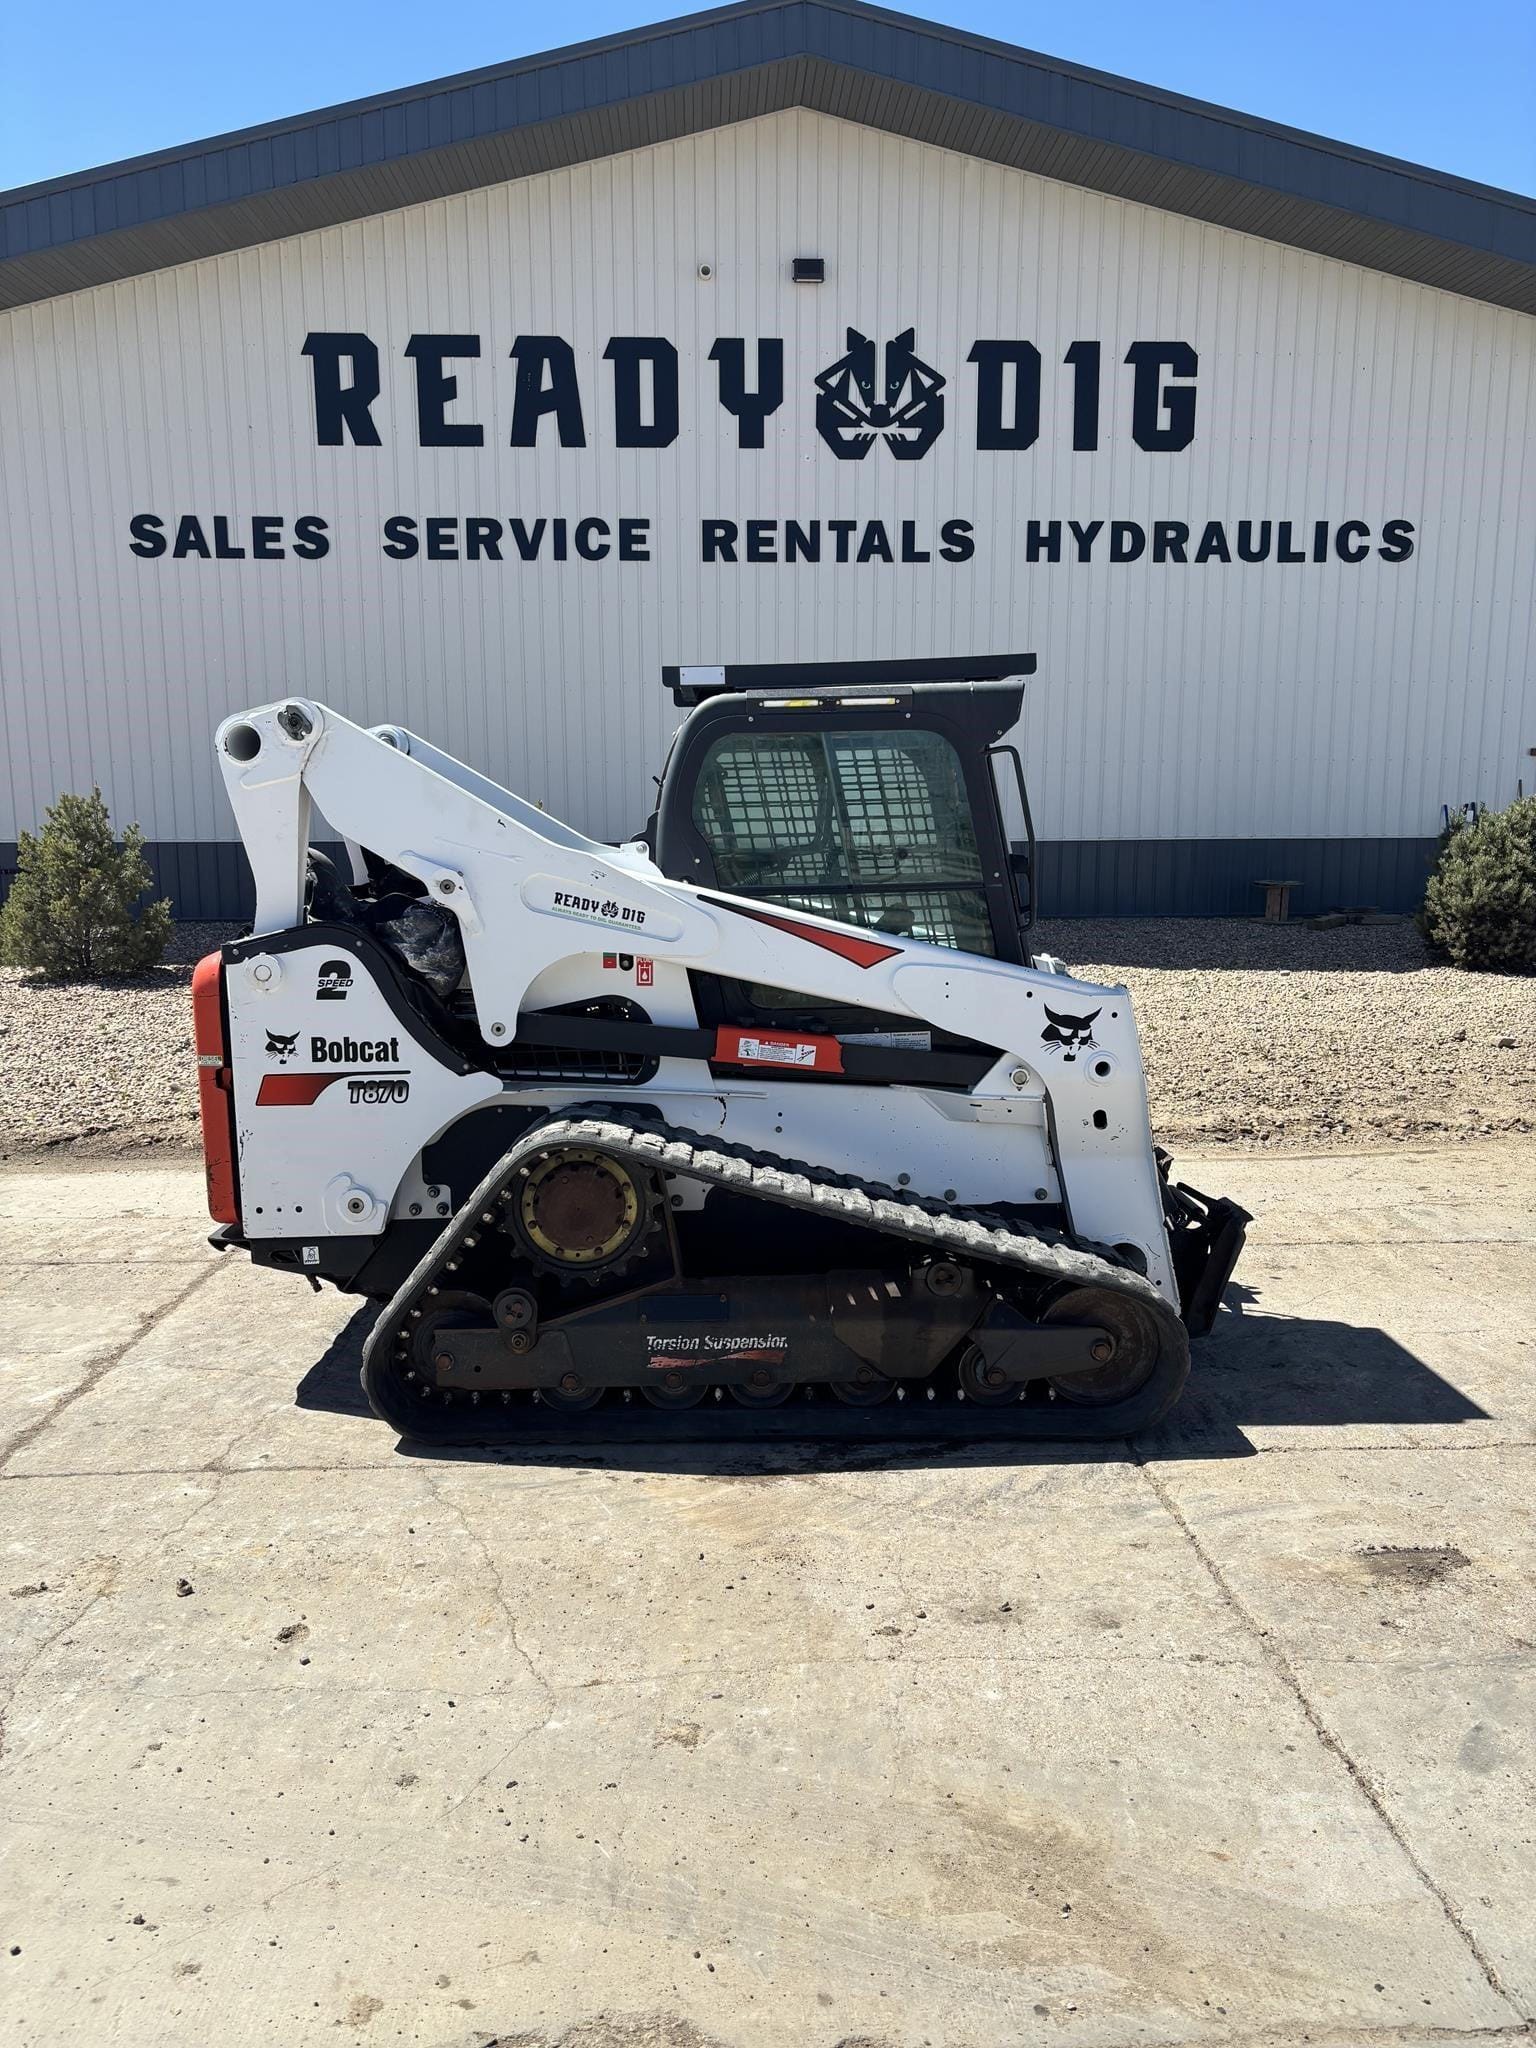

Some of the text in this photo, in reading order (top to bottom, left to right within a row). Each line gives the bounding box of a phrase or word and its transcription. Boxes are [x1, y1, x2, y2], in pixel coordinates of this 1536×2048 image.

[301, 332, 1199, 453] READY DIG
[128, 513, 1416, 564] SALES SERVICE RENTALS HYDRAULICS
[554, 892, 646, 923] READY DIG
[316, 960, 352, 1000] 2
[317, 979, 353, 987] SPEED
[310, 1036, 400, 1063] Bobcat
[347, 1080, 410, 1104] T870
[646, 1333, 788, 1352] Torsion Suspension
